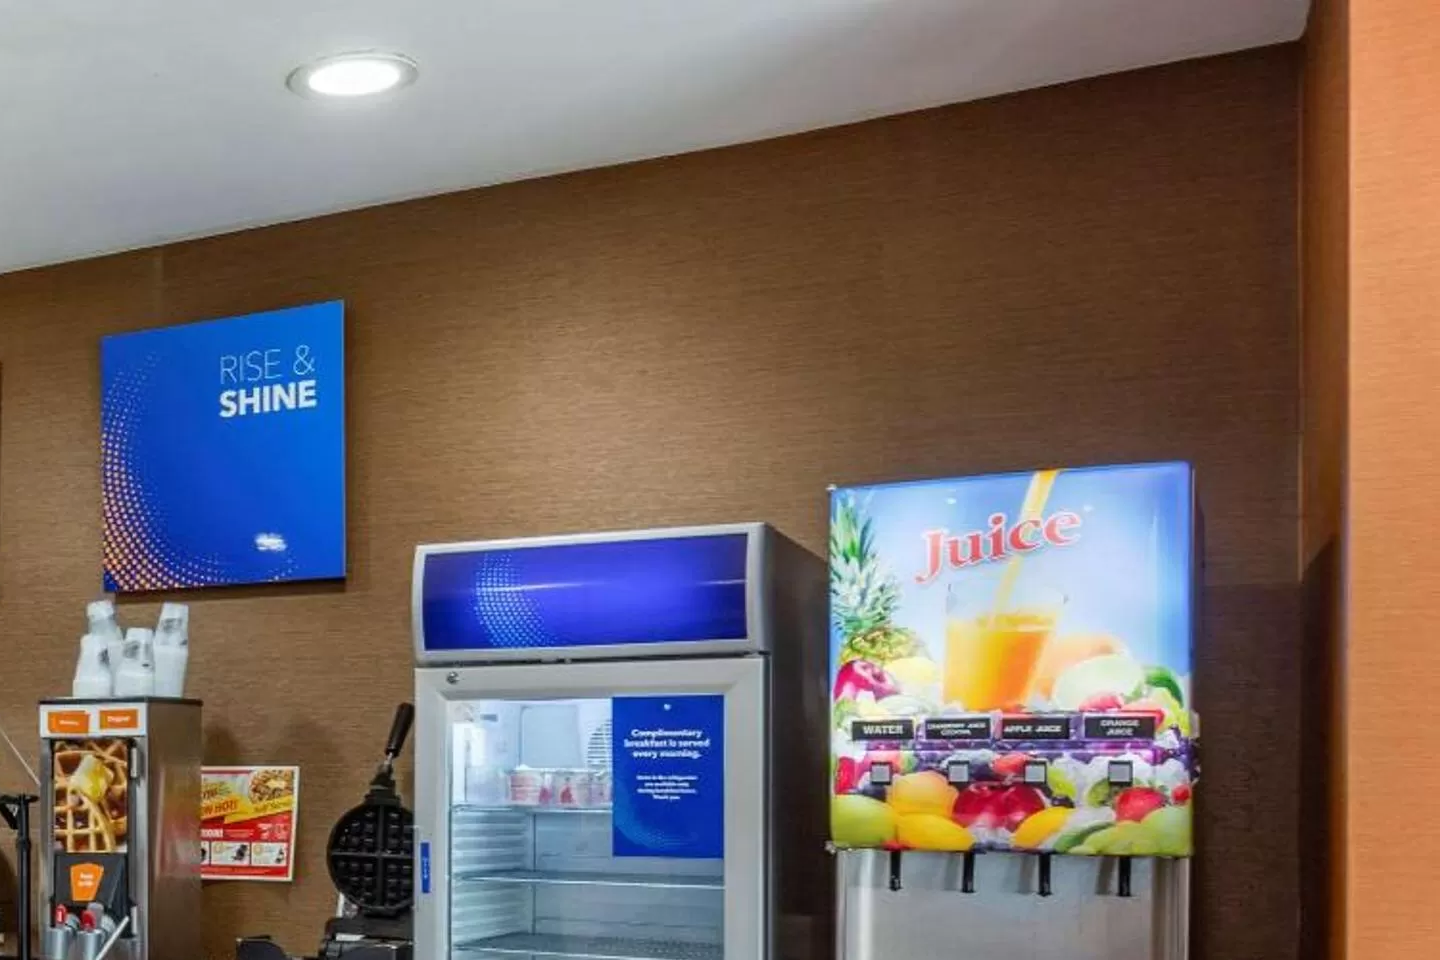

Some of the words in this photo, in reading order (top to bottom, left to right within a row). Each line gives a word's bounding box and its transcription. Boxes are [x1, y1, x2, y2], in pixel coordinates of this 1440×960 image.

[219, 349, 282, 385] RISE
[293, 344, 316, 376] &
[219, 379, 318, 418] SHINE
[915, 509, 1081, 584] Juice
[862, 724, 904, 735] WATER
